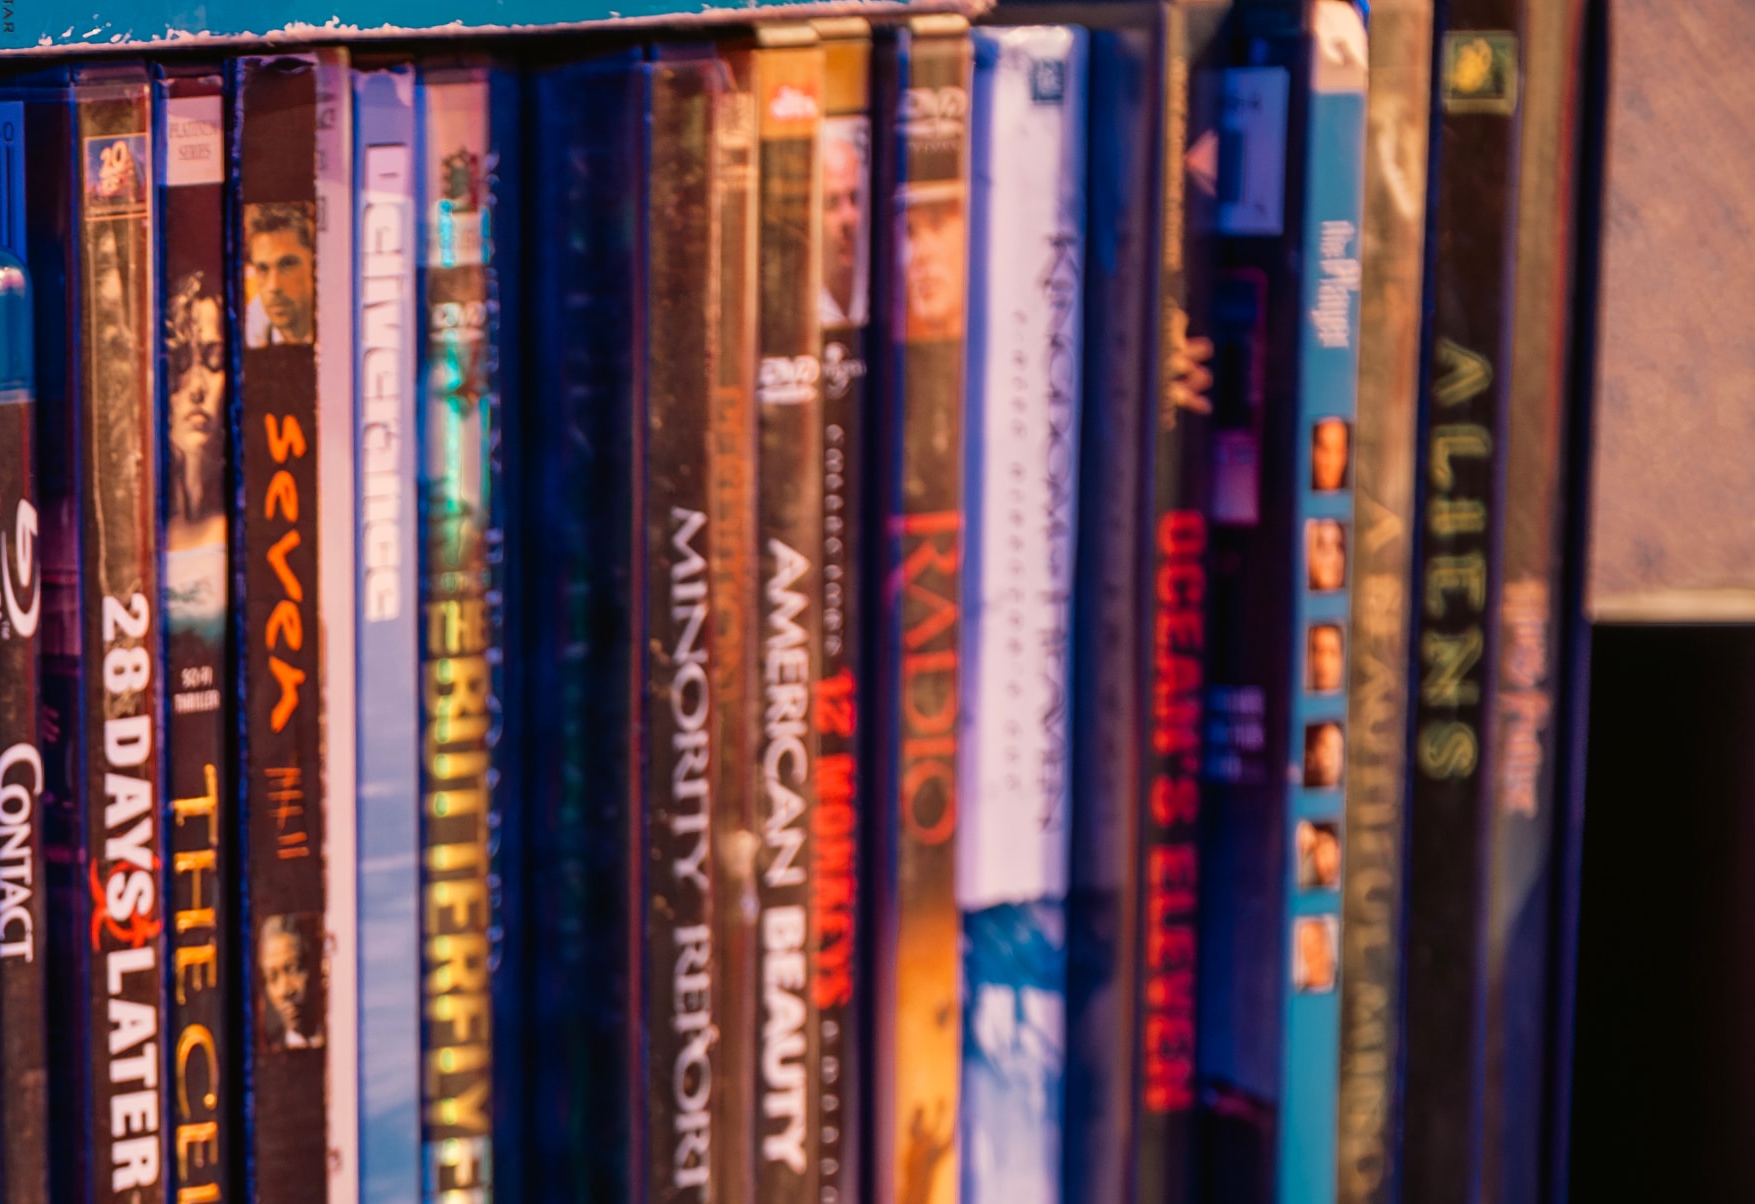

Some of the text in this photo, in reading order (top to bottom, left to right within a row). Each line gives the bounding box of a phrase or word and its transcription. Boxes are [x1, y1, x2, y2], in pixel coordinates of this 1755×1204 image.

[898, 510, 962, 846] RADIO
[1419, 335, 1494, 781] ALIENS
[102, 592, 160, 1193] 28 DAYS LATER
[170, 763, 219, 1003] THE
[424, 657, 491, 1133] BUTTERFLY
[671, 505, 713, 1200] MINORITY REPORT
[761, 537, 812, 1175] AMERICAN BEAUTY
[1145, 843, 1200, 1114] ELEVEN
